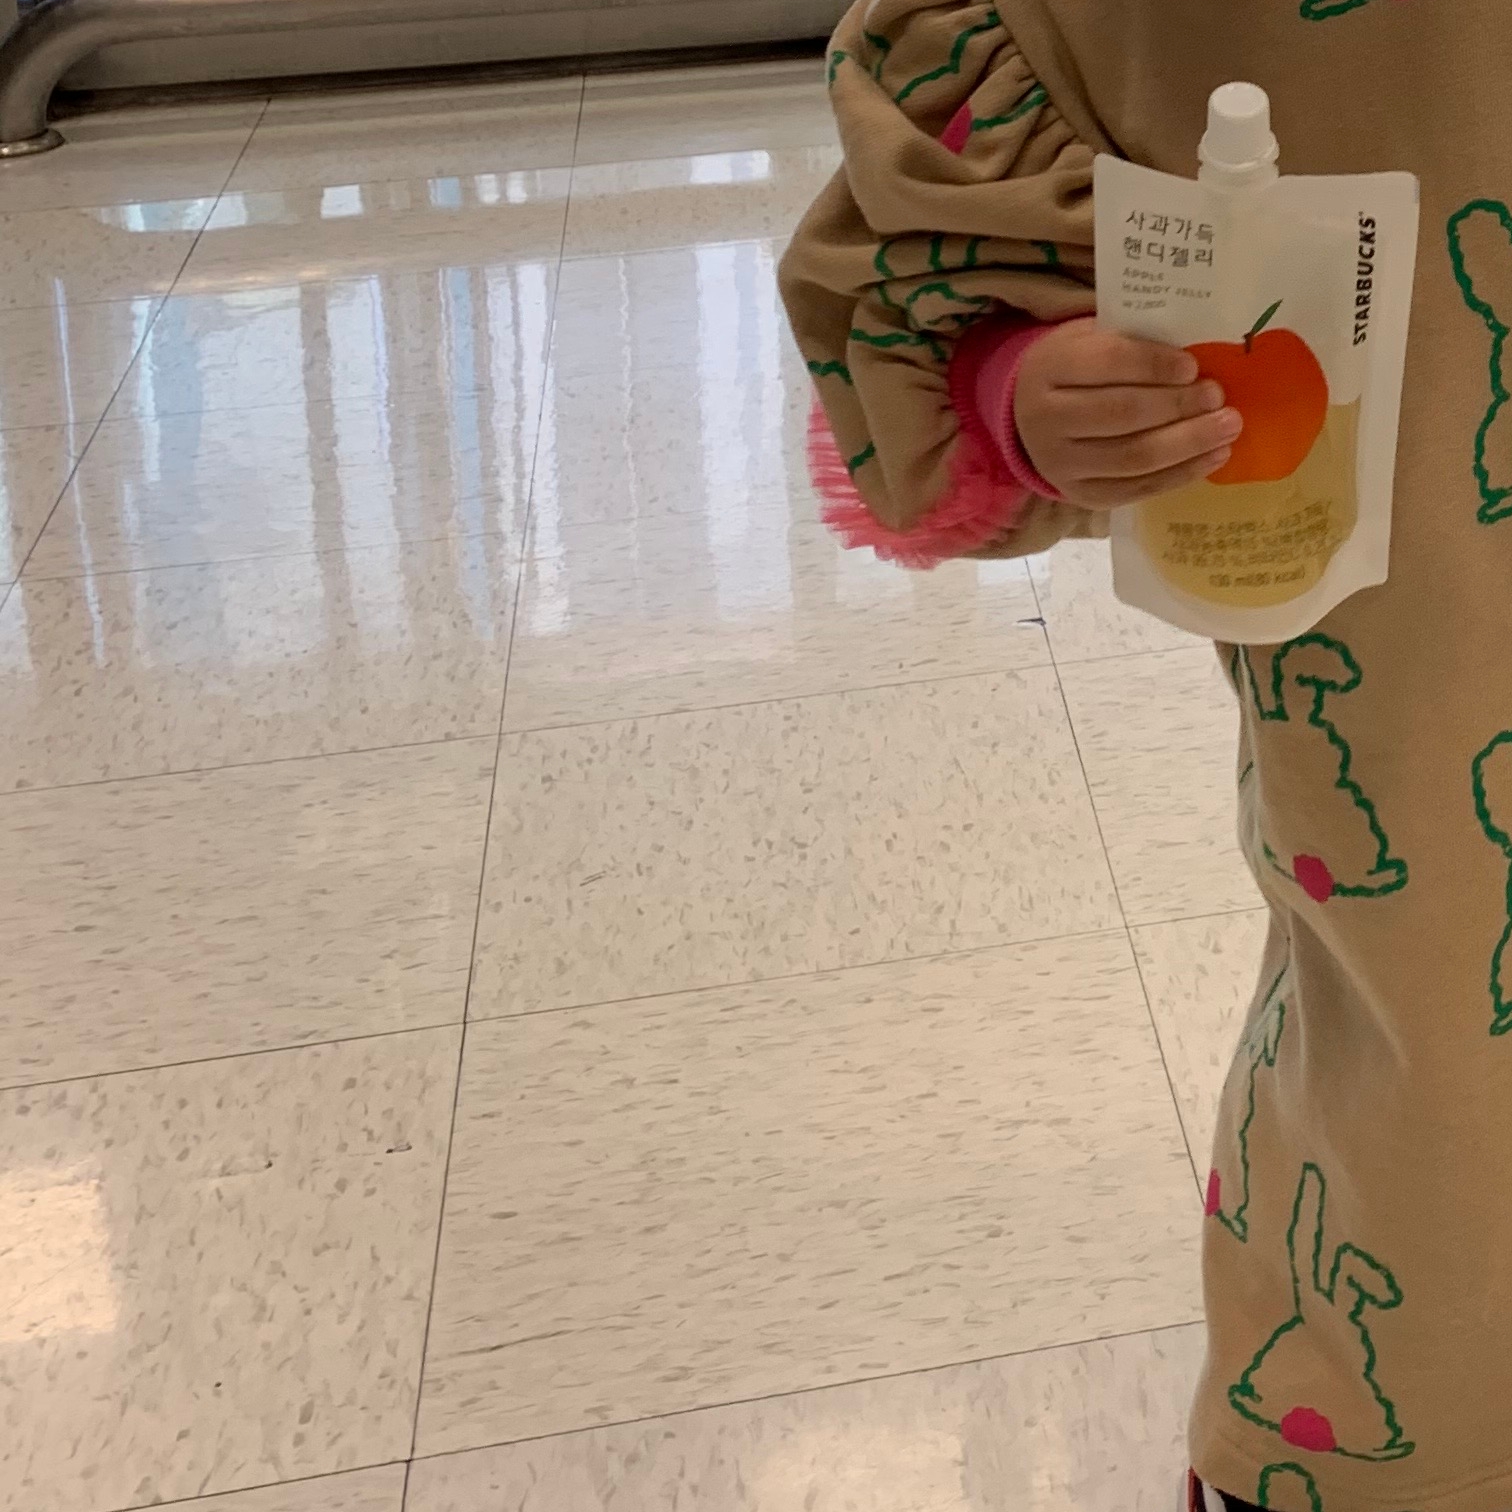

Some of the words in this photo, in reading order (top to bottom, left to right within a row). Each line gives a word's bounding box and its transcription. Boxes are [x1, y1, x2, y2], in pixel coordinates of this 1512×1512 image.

[1125, 210, 1215, 244] 사과가득
[1123, 235, 1213, 268] 핸디젤리
[1352, 215, 1377, 347] STARBUCKS
